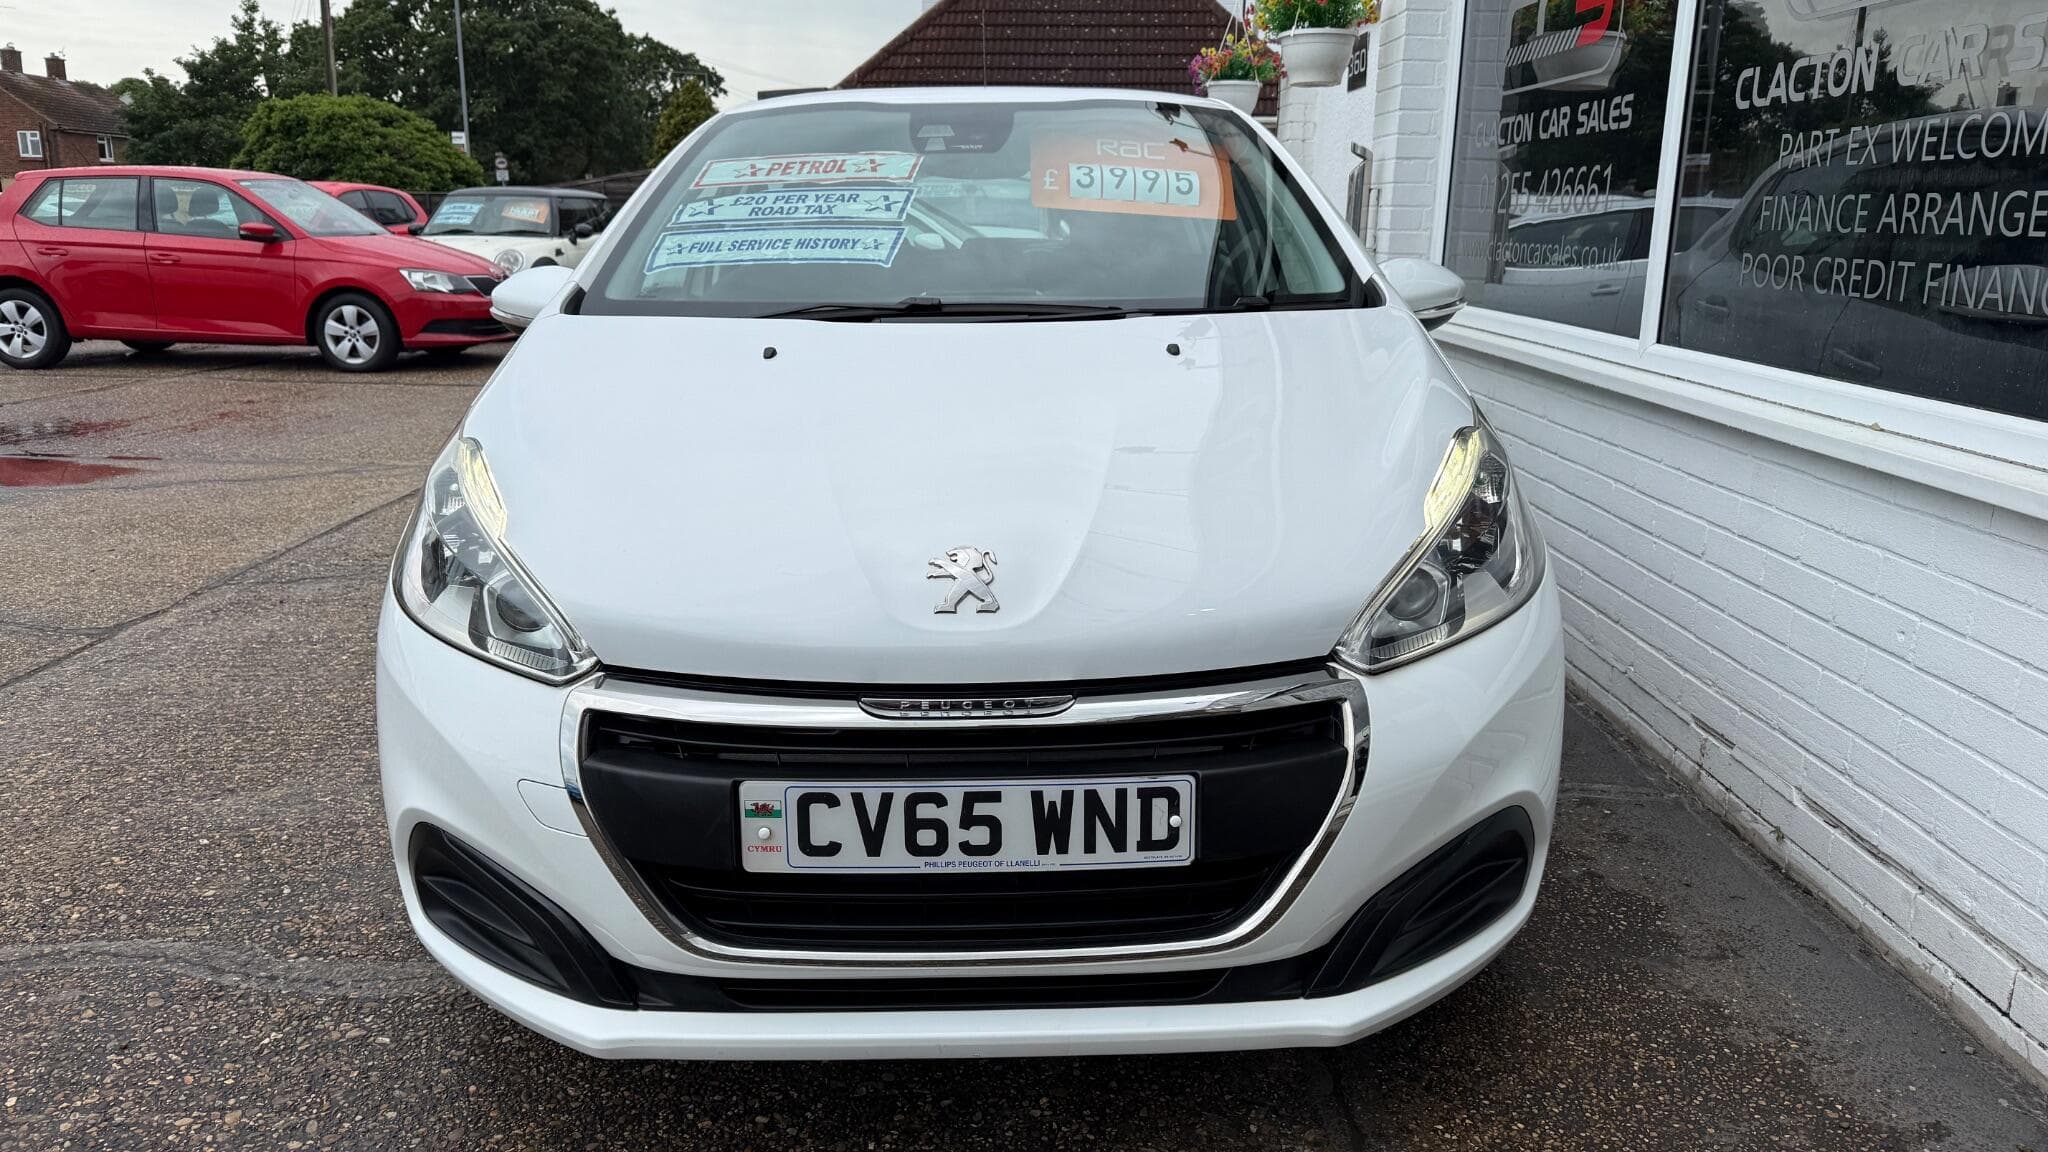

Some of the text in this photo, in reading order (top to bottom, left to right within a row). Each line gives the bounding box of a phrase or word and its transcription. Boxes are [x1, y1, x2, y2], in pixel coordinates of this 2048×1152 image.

[1735, 43, 1880, 110] CLACTON
[1475, 92, 1635, 148] CLACTON CAR SALES
[1778, 107, 2048, 169] PART EX WELCOM
[765, 159, 848, 177] PETROL
[1043, 165, 1194, 196] £ 3995
[729, 192, 861, 208] £20 PER YEAR
[1479, 163, 1613, 214] 01255 426661
[748, 204, 838, 217] ROAD TAX
[1759, 190, 2048, 238] FINANCE ARRANGE
[688, 237, 862, 254] FULL SERVICE HISTORY
[1739, 252, 1806, 292] POOR
[1813, 256, 1916, 303] CREDIT
[900, 699, 1034, 710] PEUGEOT
[797, 786, 1181, 858] CV65 WND
[747, 845, 783, 853] CYMRU
[924, 861, 957, 869] PHILLIPS
[958, 860, 993, 868] PEUGEOT
[995, 860, 1005, 868] OF
[1006, 859, 1041, 868] LLANELLI
